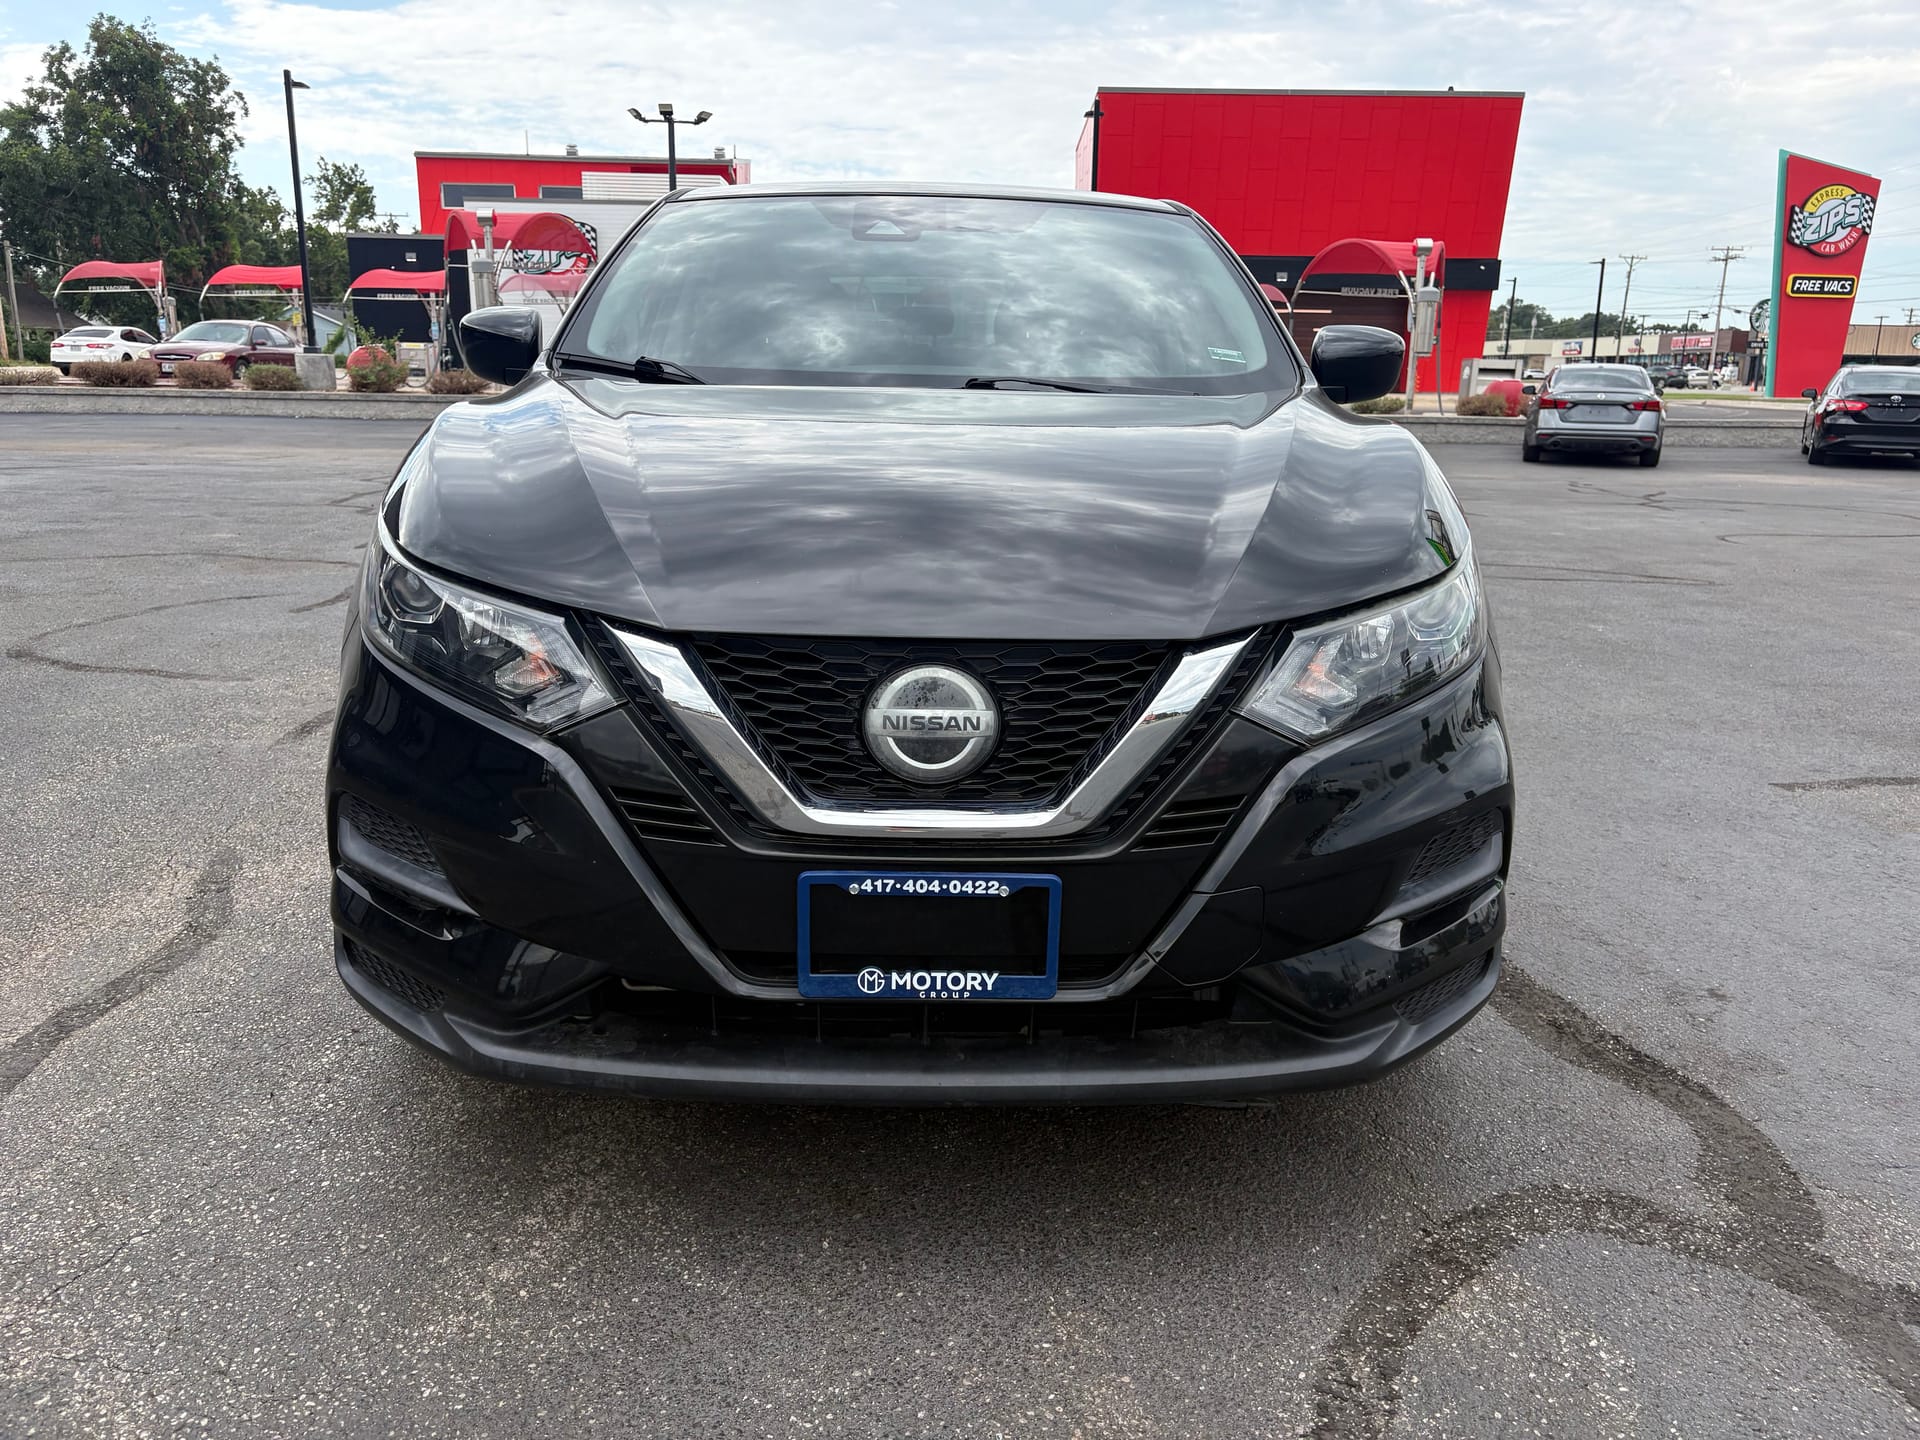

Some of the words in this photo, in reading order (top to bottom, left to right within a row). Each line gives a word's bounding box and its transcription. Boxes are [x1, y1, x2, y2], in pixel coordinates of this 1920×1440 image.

[1810, 187, 1845, 208] EXPRESS
[1803, 197, 1862, 242] ZIPS
[1820, 242, 1836, 253] CAR
[1838, 230, 1859, 250] WASH
[1793, 279, 1824, 291] FREE
[1823, 280, 1853, 292] VACS
[882, 714, 981, 731] NISSAN
[890, 971, 1000, 991] MOTORY
